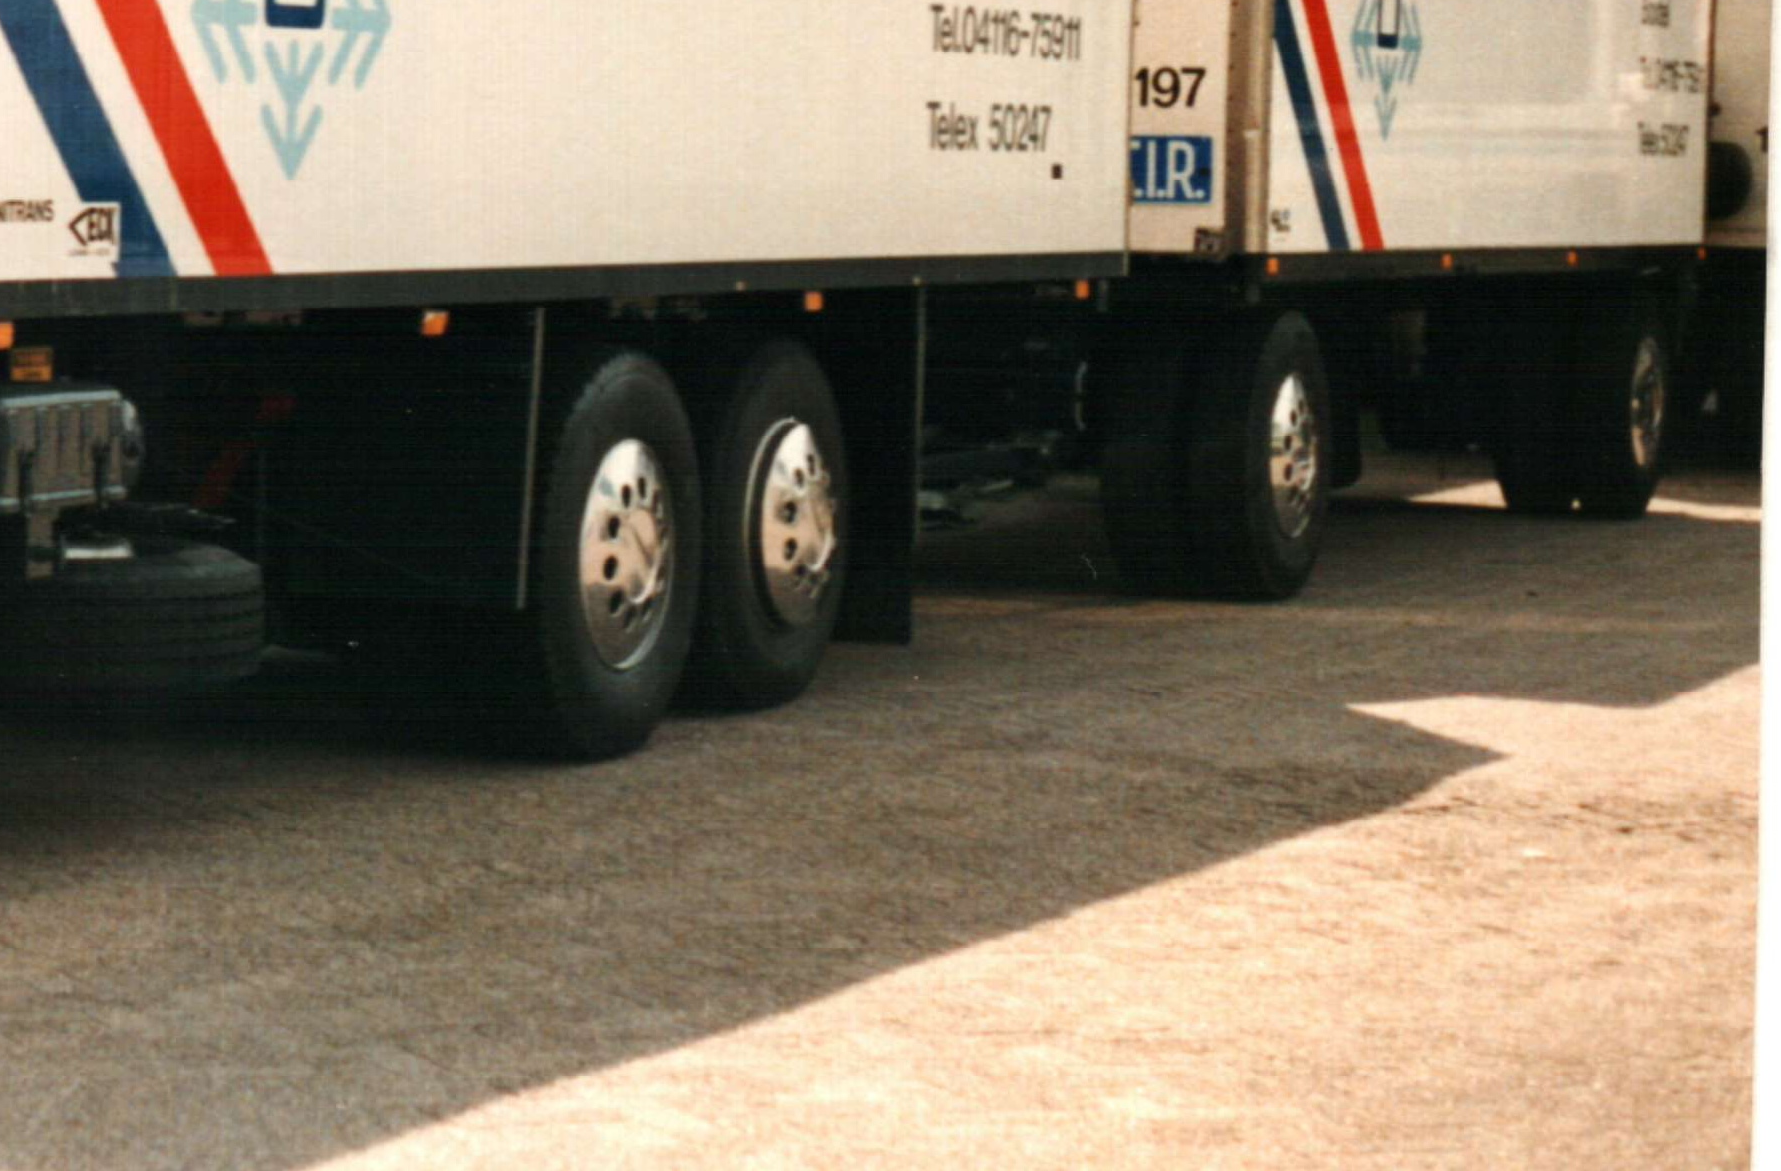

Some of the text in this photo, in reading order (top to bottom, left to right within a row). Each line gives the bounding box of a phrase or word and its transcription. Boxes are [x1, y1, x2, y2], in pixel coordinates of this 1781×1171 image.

[1135, 65, 1206, 109] 197
[926, 100, 1052, 152] Telex 50247
